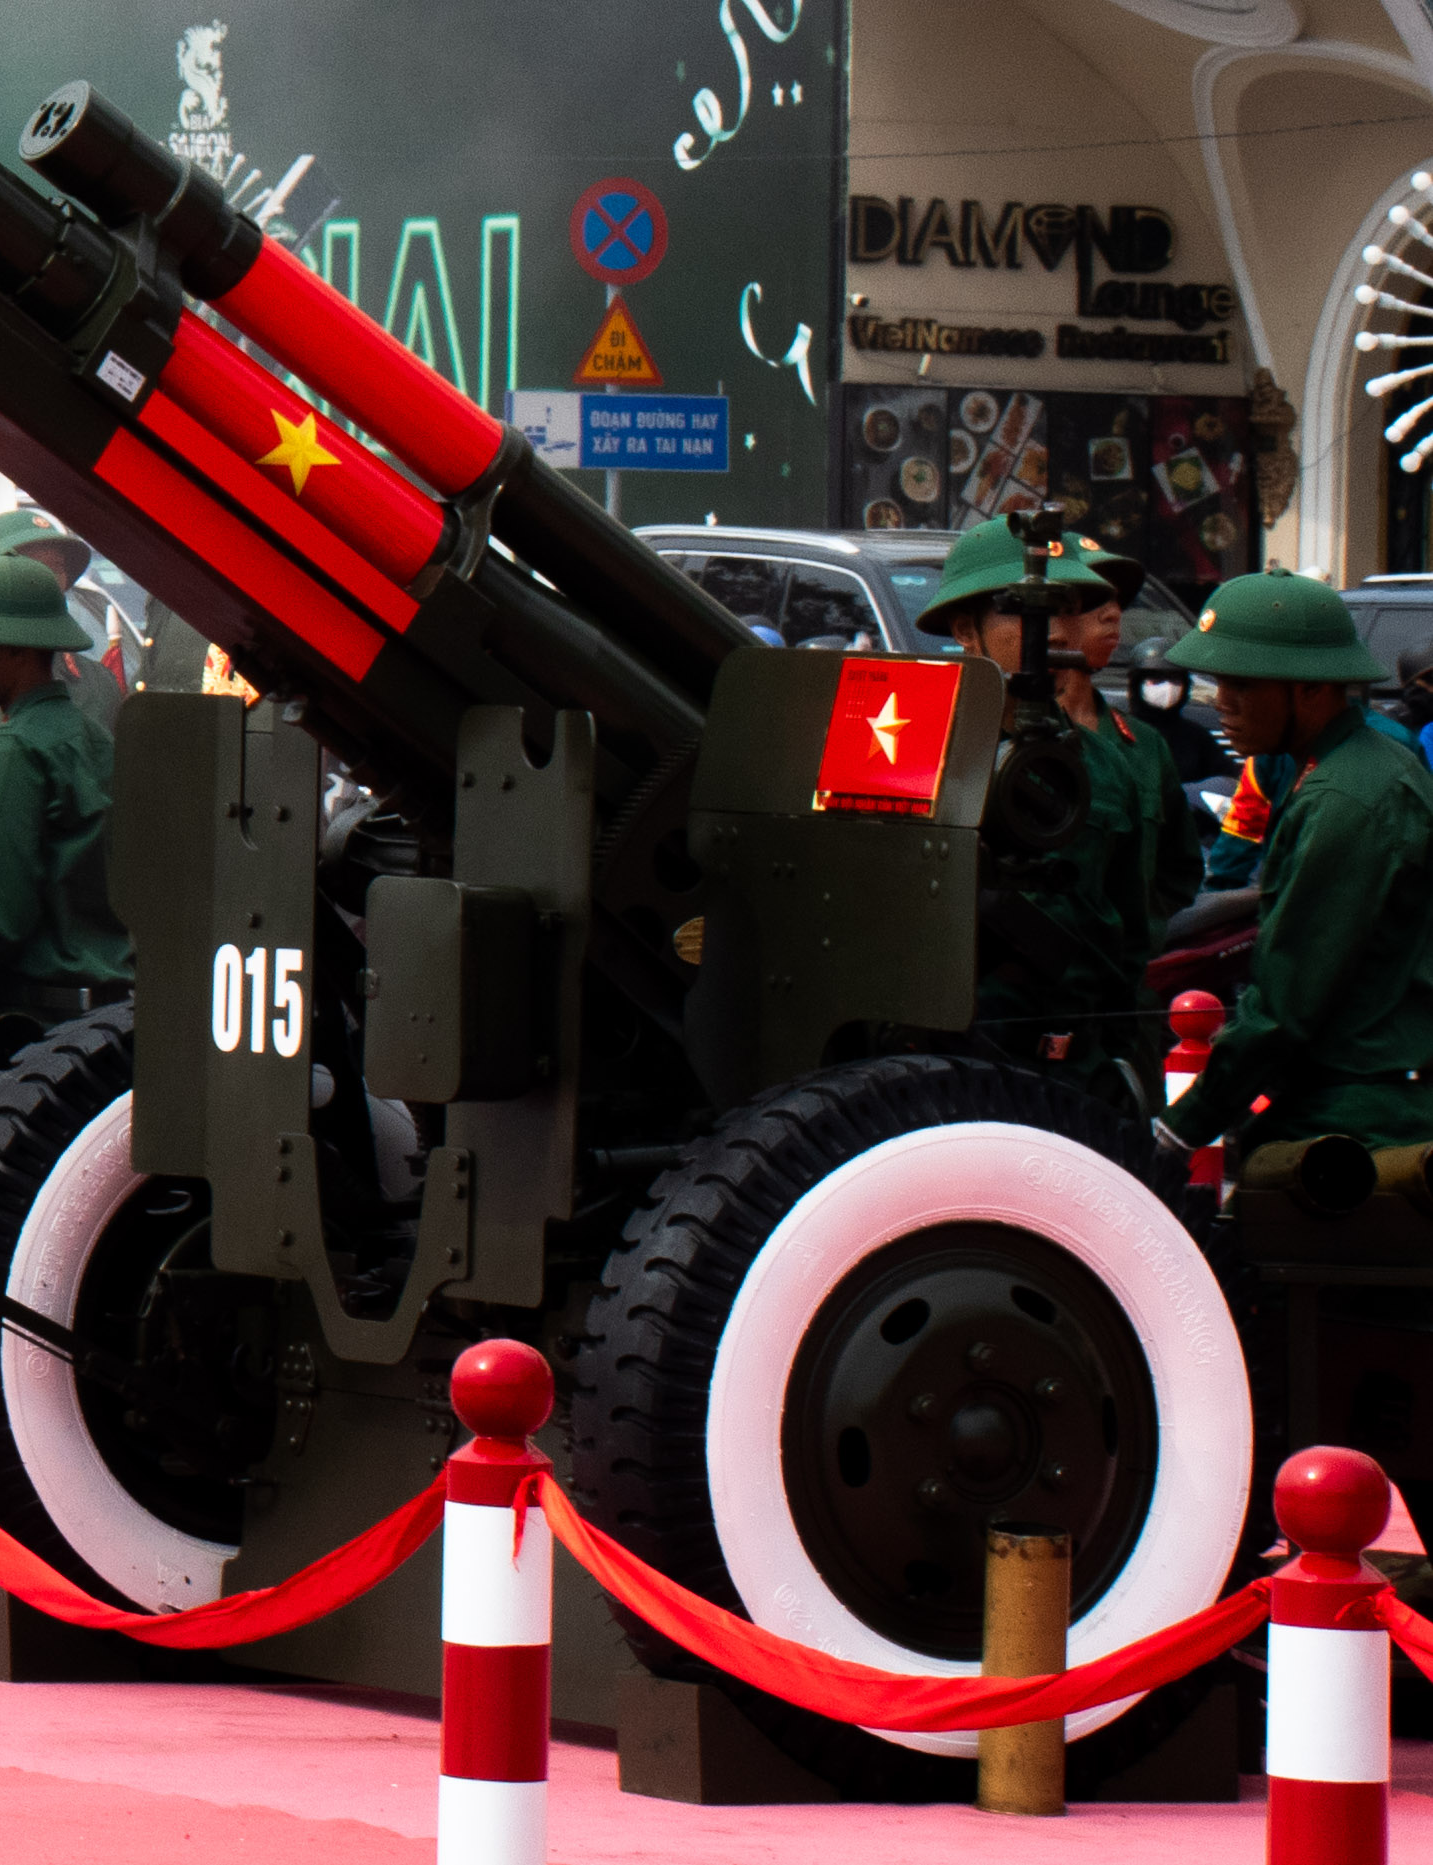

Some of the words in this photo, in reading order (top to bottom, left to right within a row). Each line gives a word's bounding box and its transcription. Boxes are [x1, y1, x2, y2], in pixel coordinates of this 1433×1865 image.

[610, 330, 626, 347] ĐI
[691, 412, 719, 430] HAY
[626, 437, 648, 454] RA
[655, 438, 677, 454] TAI
[682, 438, 714, 458] NẠN
[211, 942, 304, 1058] 015
